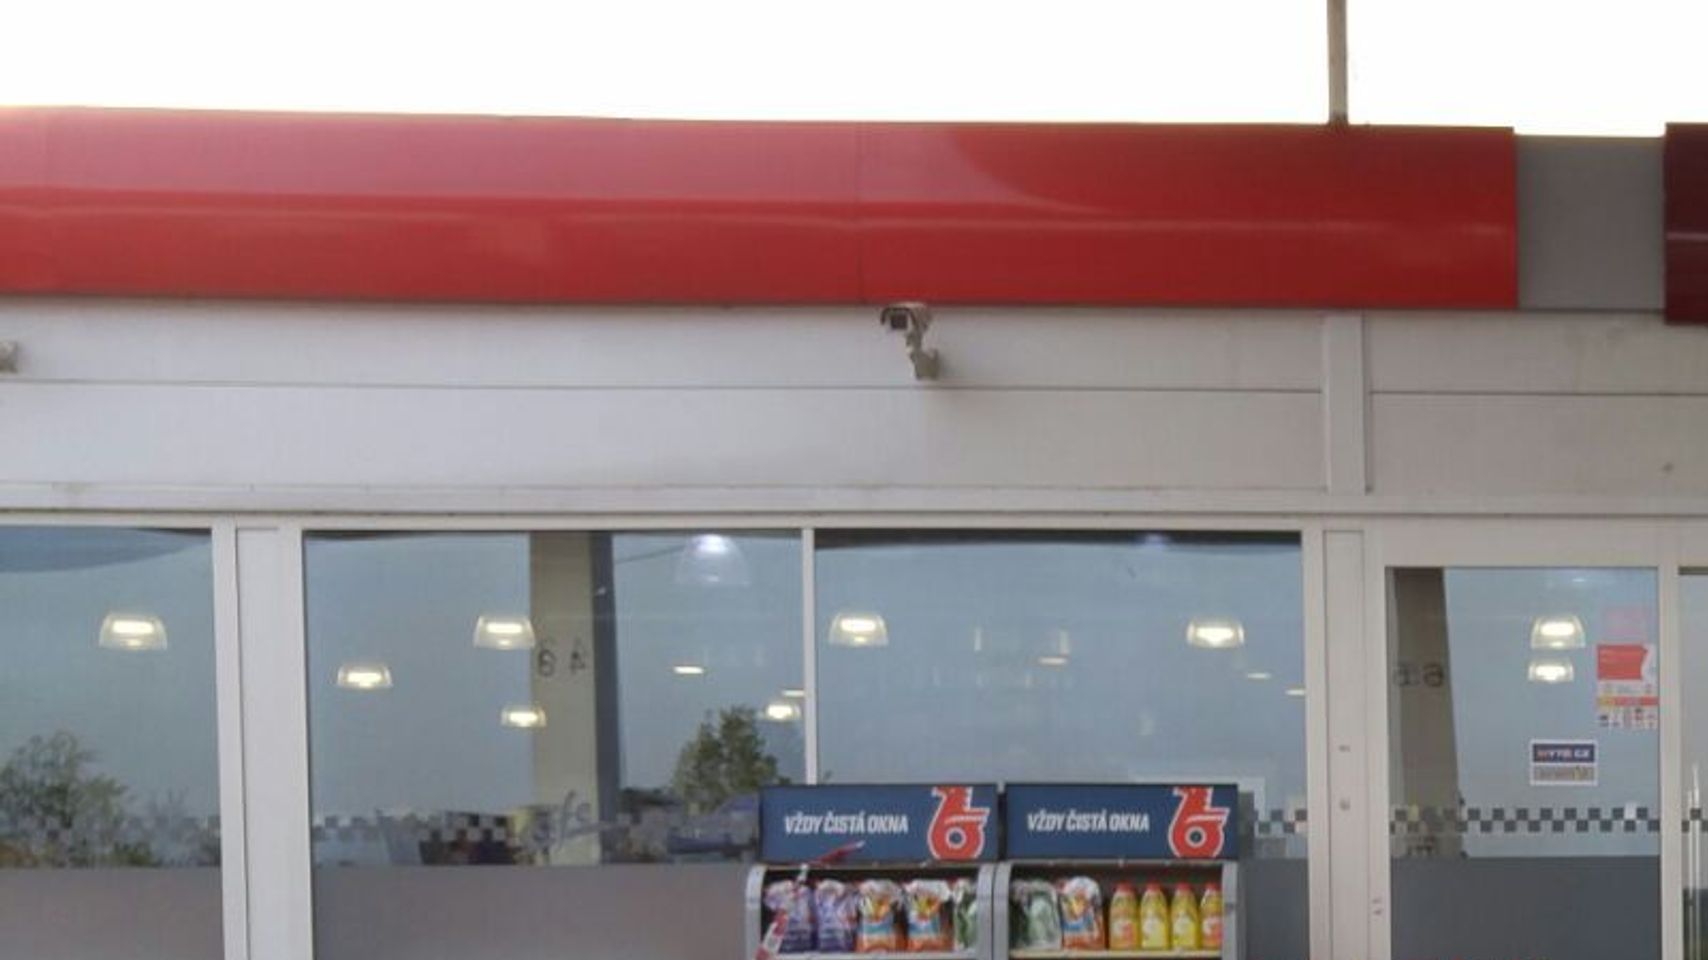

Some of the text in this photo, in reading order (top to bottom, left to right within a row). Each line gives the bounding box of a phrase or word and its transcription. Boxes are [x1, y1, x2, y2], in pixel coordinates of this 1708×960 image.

[784, 810, 909, 834] VŽDY ČISTÁ OKNA
[1027, 808, 1149, 832] VŽDY ČISTÁ OKNA
